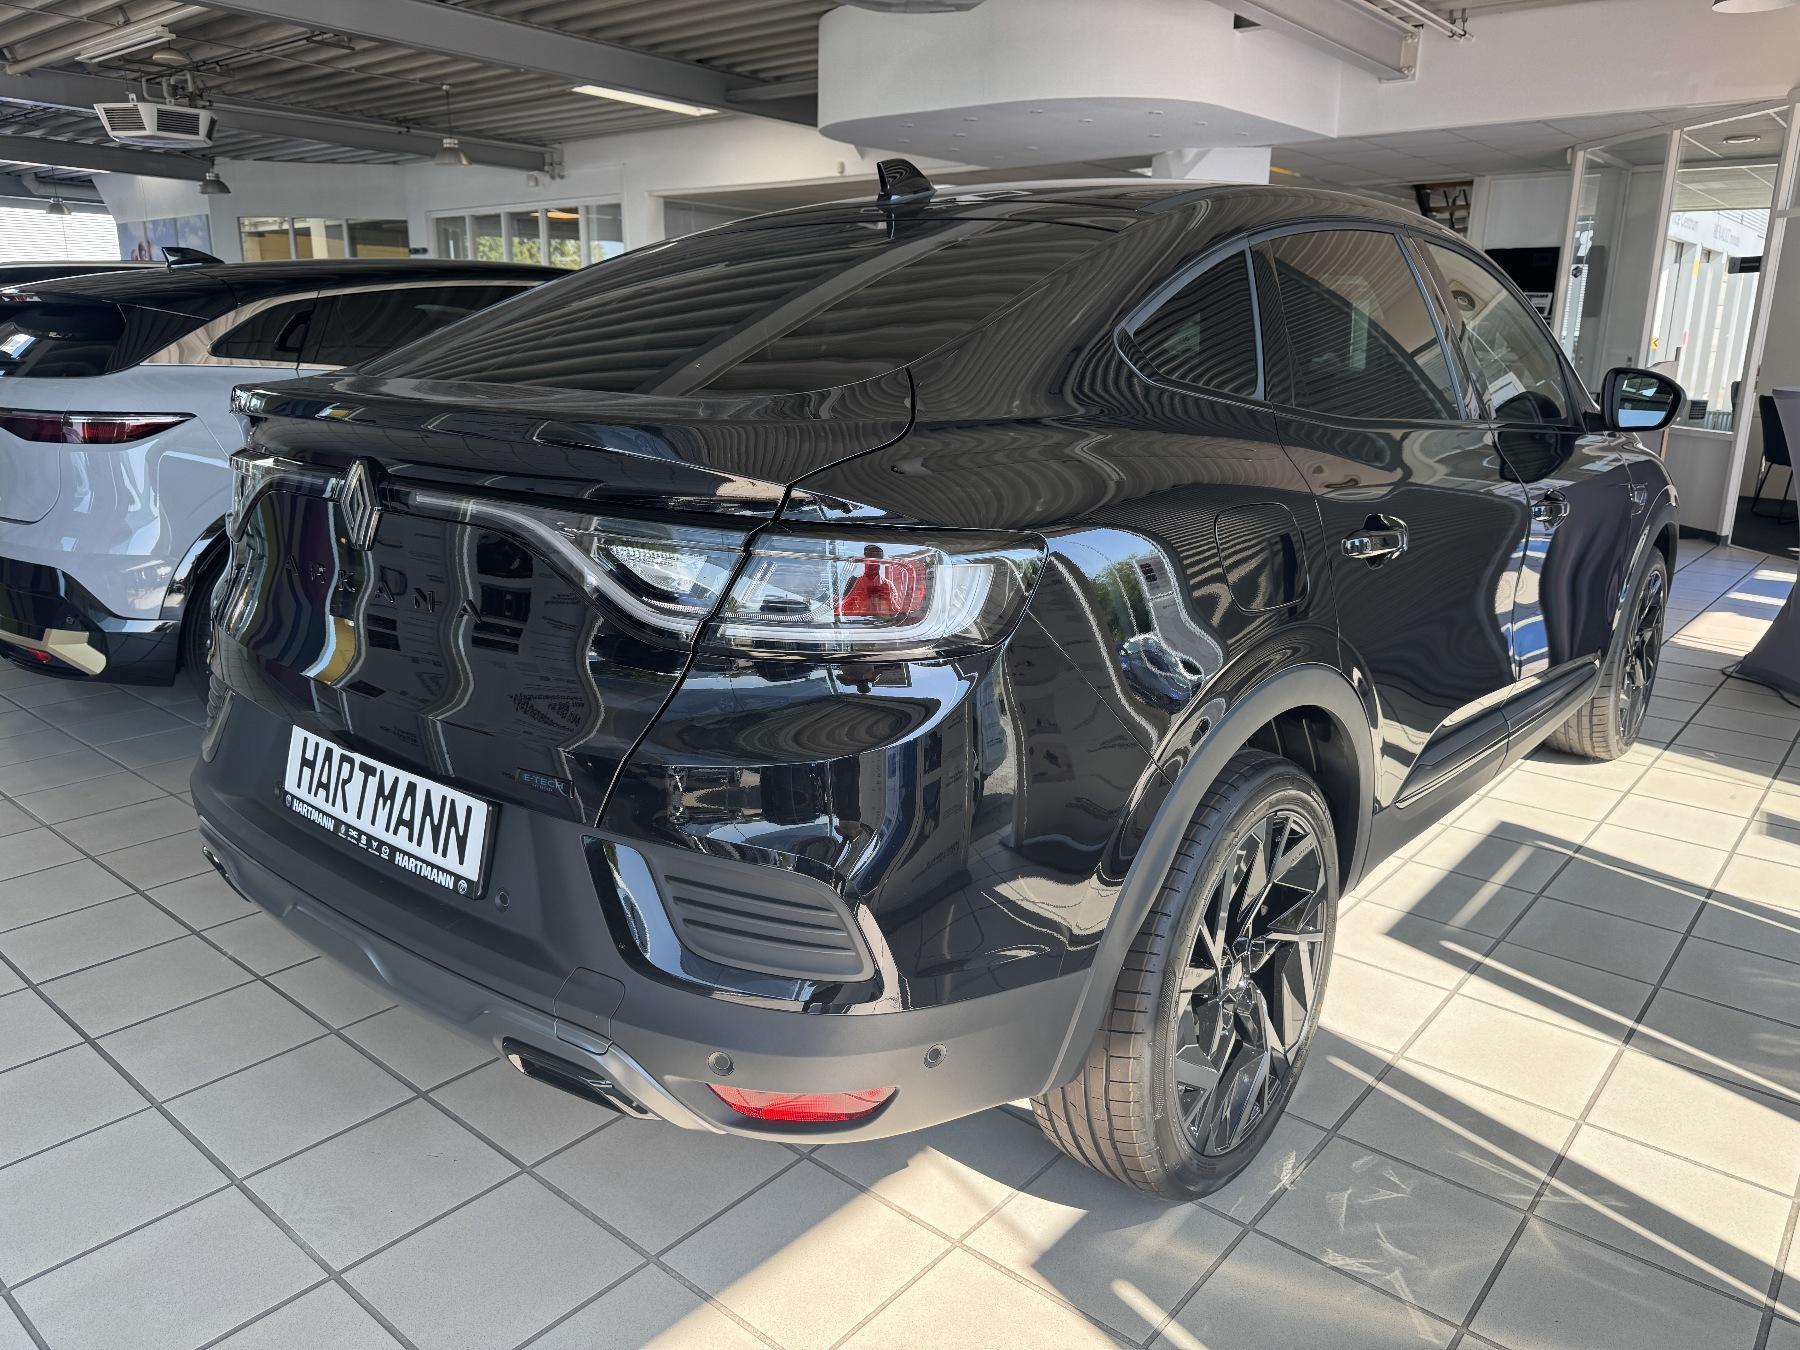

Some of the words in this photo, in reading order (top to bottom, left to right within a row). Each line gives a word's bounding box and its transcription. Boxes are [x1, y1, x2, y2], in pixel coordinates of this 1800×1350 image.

[284, 554, 482, 625] ARKANA
[296, 736, 473, 866] HARTMANN
[523, 773, 564, 790] E-TECH
[293, 798, 335, 832] HARTMANN
[394, 851, 455, 890] HARTMANN
